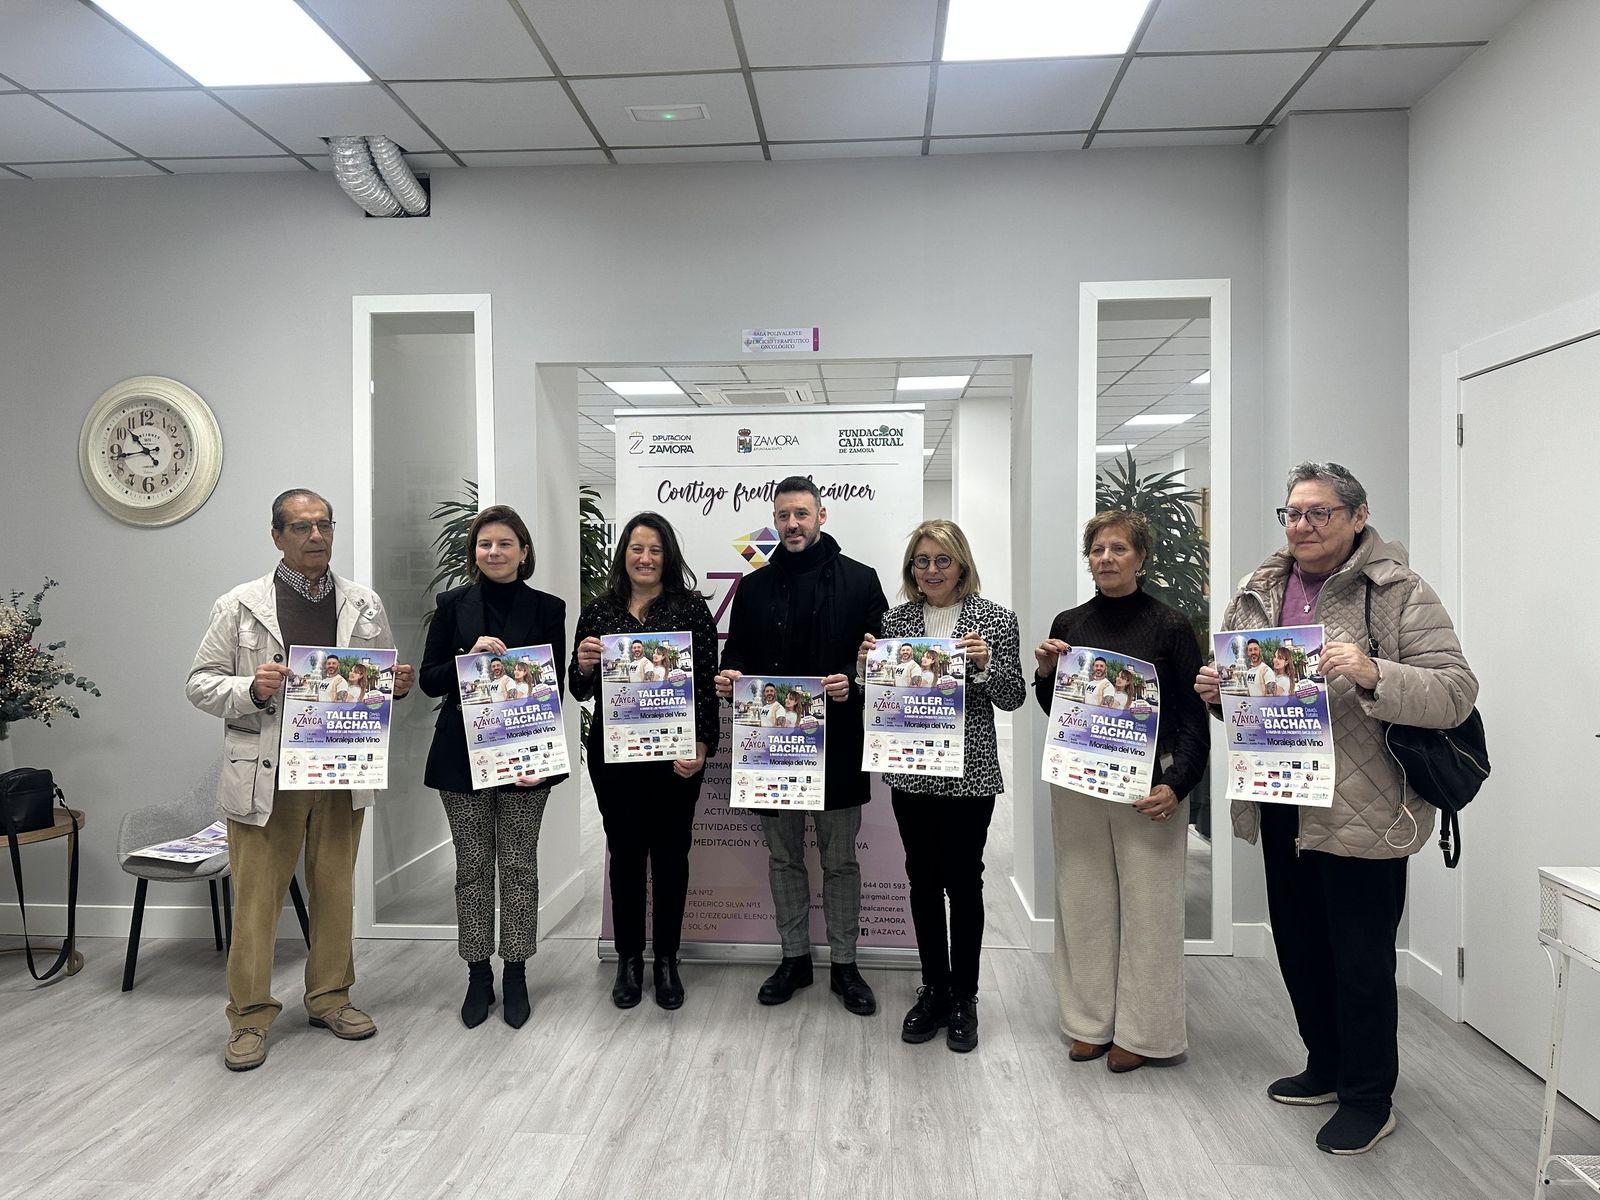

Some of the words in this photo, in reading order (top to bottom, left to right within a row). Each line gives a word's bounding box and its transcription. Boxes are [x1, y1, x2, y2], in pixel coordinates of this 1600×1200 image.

[128, 417, 135, 429] 11
[140, 410, 154, 426] 12
[163, 417, 166, 428] 1
[116, 427, 126, 440] 10
[170, 426, 177, 438] 2
[754, 436, 800, 446] ZAMORA
[838, 438, 864, 447] CAJA
[868, 438, 904, 446] RURAL
[110, 444, 122, 460] 9
[174, 442, 185, 460] 3
[649, 445, 694, 454] ZAMORA
[117, 463, 124, 475] 8
[172, 462, 180, 475] 4
[129, 474, 135, 486] 7
[142, 476, 154, 493] 6
[161, 474, 168, 486] 5
[658, 480, 728, 516] Contigo
[734, 480, 778, 512] frent
[819, 482, 876, 501] cáncer
[637, 689, 674, 698] TALLER
[610, 694, 636, 706] AZAYCA
[640, 697, 687, 706] BACHATA
[873, 698, 901, 711] AZAYCA
[902, 696, 942, 705] TALLER
[326, 711, 368, 720] TALLER
[501, 704, 540, 717] TALLER
[640, 712, 664, 720] Moraleja
[904, 706, 956, 716] BACHATA
[1259, 707, 1304, 718] TALLER
[292, 714, 322, 727] AZAYCA
[473, 716, 500, 729] AZAYCA
[504, 711, 555, 726] BACHATA
[875, 716, 880, 724] 8
[1058, 713, 1088, 727] AZAYCA
[1090, 714, 1134, 730] TALLER
[1232, 711, 1260, 726] AZAYCA
[1264, 719, 1321, 729] BACHATA
[326, 720, 382, 730] BACHATA
[904, 721, 930, 729] Moraleja
[293, 732, 299, 740] 8
[506, 730, 532, 739] Moraleja
[1091, 724, 1147, 742] BACHATA
[1237, 733, 1242, 741] 8
[326, 736, 353, 744] Moraleja
[740, 738, 765, 750] AZAYCA
[768, 736, 804, 744] TALLER
[1267, 738, 1296, 748] Moraleja
[1296, 738, 1306, 746] del
[1307, 739, 1323, 747] Vino
[769, 744, 818, 753] BACHATA
[1089, 741, 1118, 752] Moraleja
[1129, 748, 1145, 757] Vino
[769, 759, 794, 767] Moraleja
[694, 838, 750, 846] MEDITACIÓN
